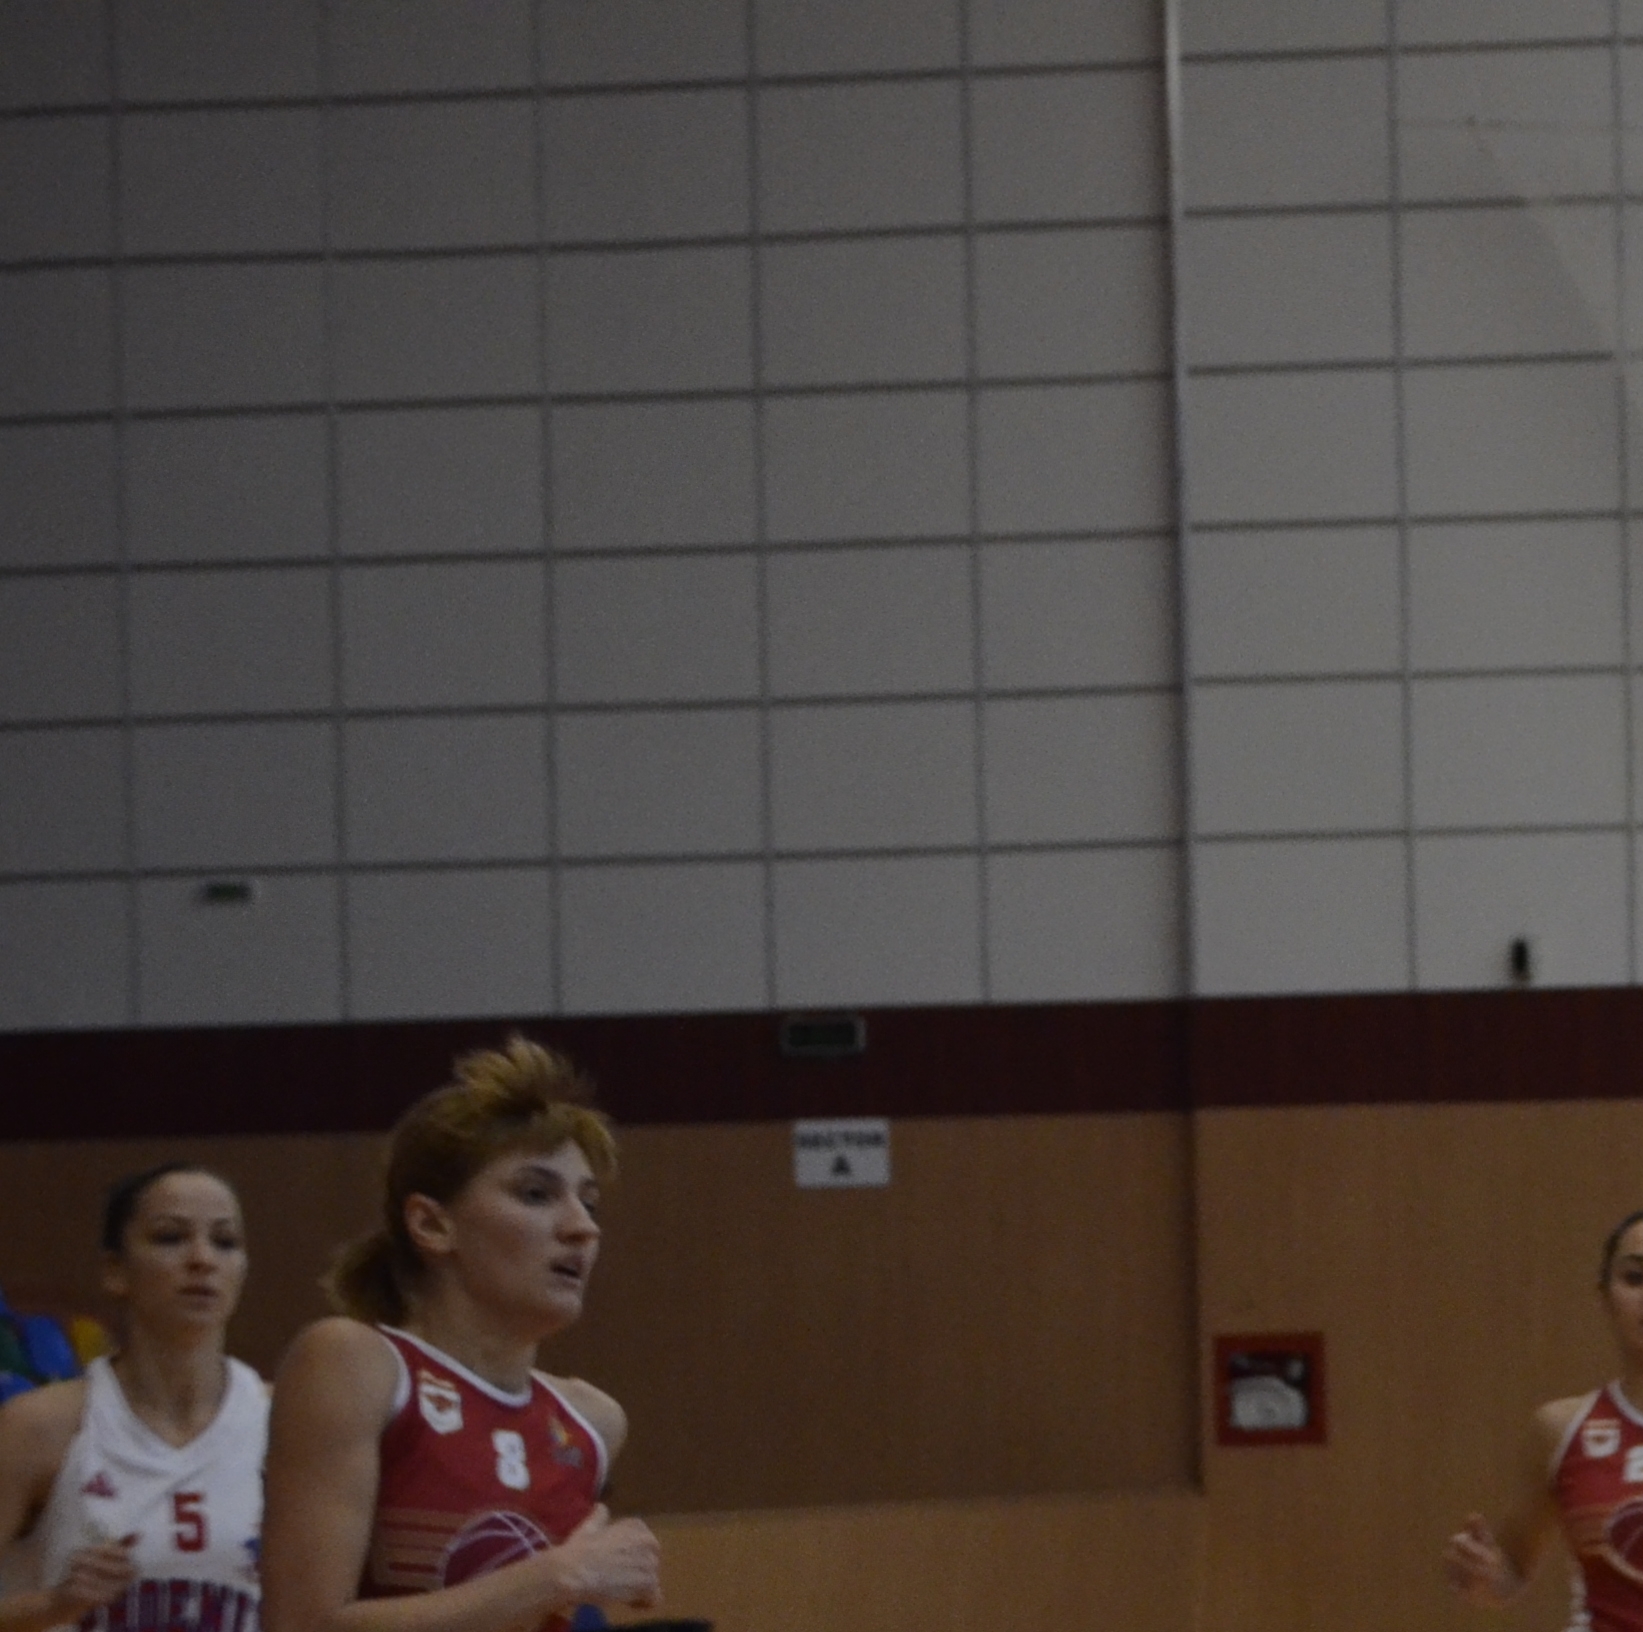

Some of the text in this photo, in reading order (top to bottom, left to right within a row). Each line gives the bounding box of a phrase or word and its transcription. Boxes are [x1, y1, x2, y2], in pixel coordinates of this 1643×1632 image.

[831, 1155, 850, 1174] A
[491, 1428, 531, 1490] 8
[173, 1493, 205, 1552] 5
